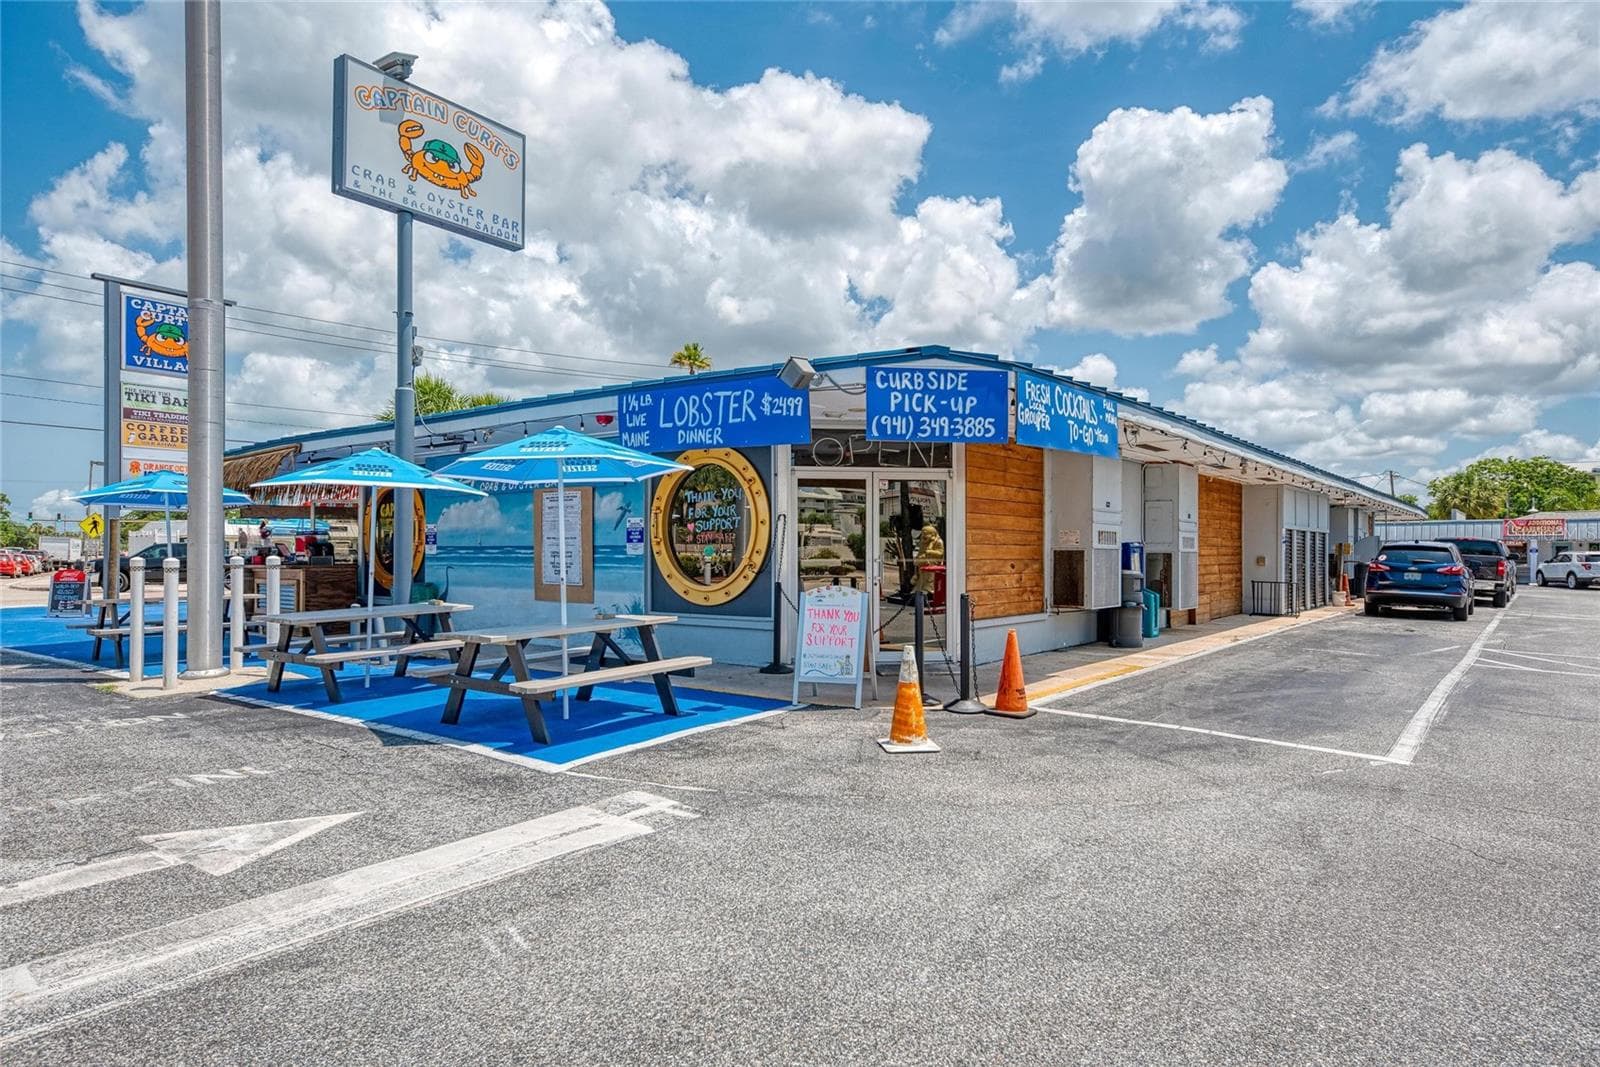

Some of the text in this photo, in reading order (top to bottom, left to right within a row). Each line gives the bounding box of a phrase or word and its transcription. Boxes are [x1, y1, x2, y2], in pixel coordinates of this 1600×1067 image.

[355, 86, 520, 170] CAPTAIN CURT'S
[352, 165, 519, 233] CRAB & OYSTER BAR
[354, 180, 518, 242] & THE BACKROOM SALOON
[131, 299, 188, 318] CAPTA
[141, 310, 188, 326] CURT'
[132, 355, 188, 372] VILLA
[124, 392, 157, 404] TIKI
[1026, 380, 1051, 406] FRESH
[659, 389, 757, 428] LOBSTER
[1055, 386, 1098, 425] COCKTAILS
[626, 413, 647, 427] LIVE
[1018, 402, 1051, 432] GROUPER
[126, 422, 188, 435] COFFEE
[678, 427, 724, 445] DINNER
[872, 415, 914, 440] (941)
[1067, 420, 1094, 446] TO-GO
[138, 432, 188, 444] GARDE
[622, 431, 651, 448] MAINE
[813, 434, 933, 467] OPEN
[685, 488, 742, 503] THANK YOU
[688, 504, 737, 519] FOR YOUR
[696, 516, 741, 533] SUPPORT
[808, 608, 860, 622] THANK YOU
[812, 622, 848, 636] FOR YOUR
[806, 633, 856, 648] SUPPORT
